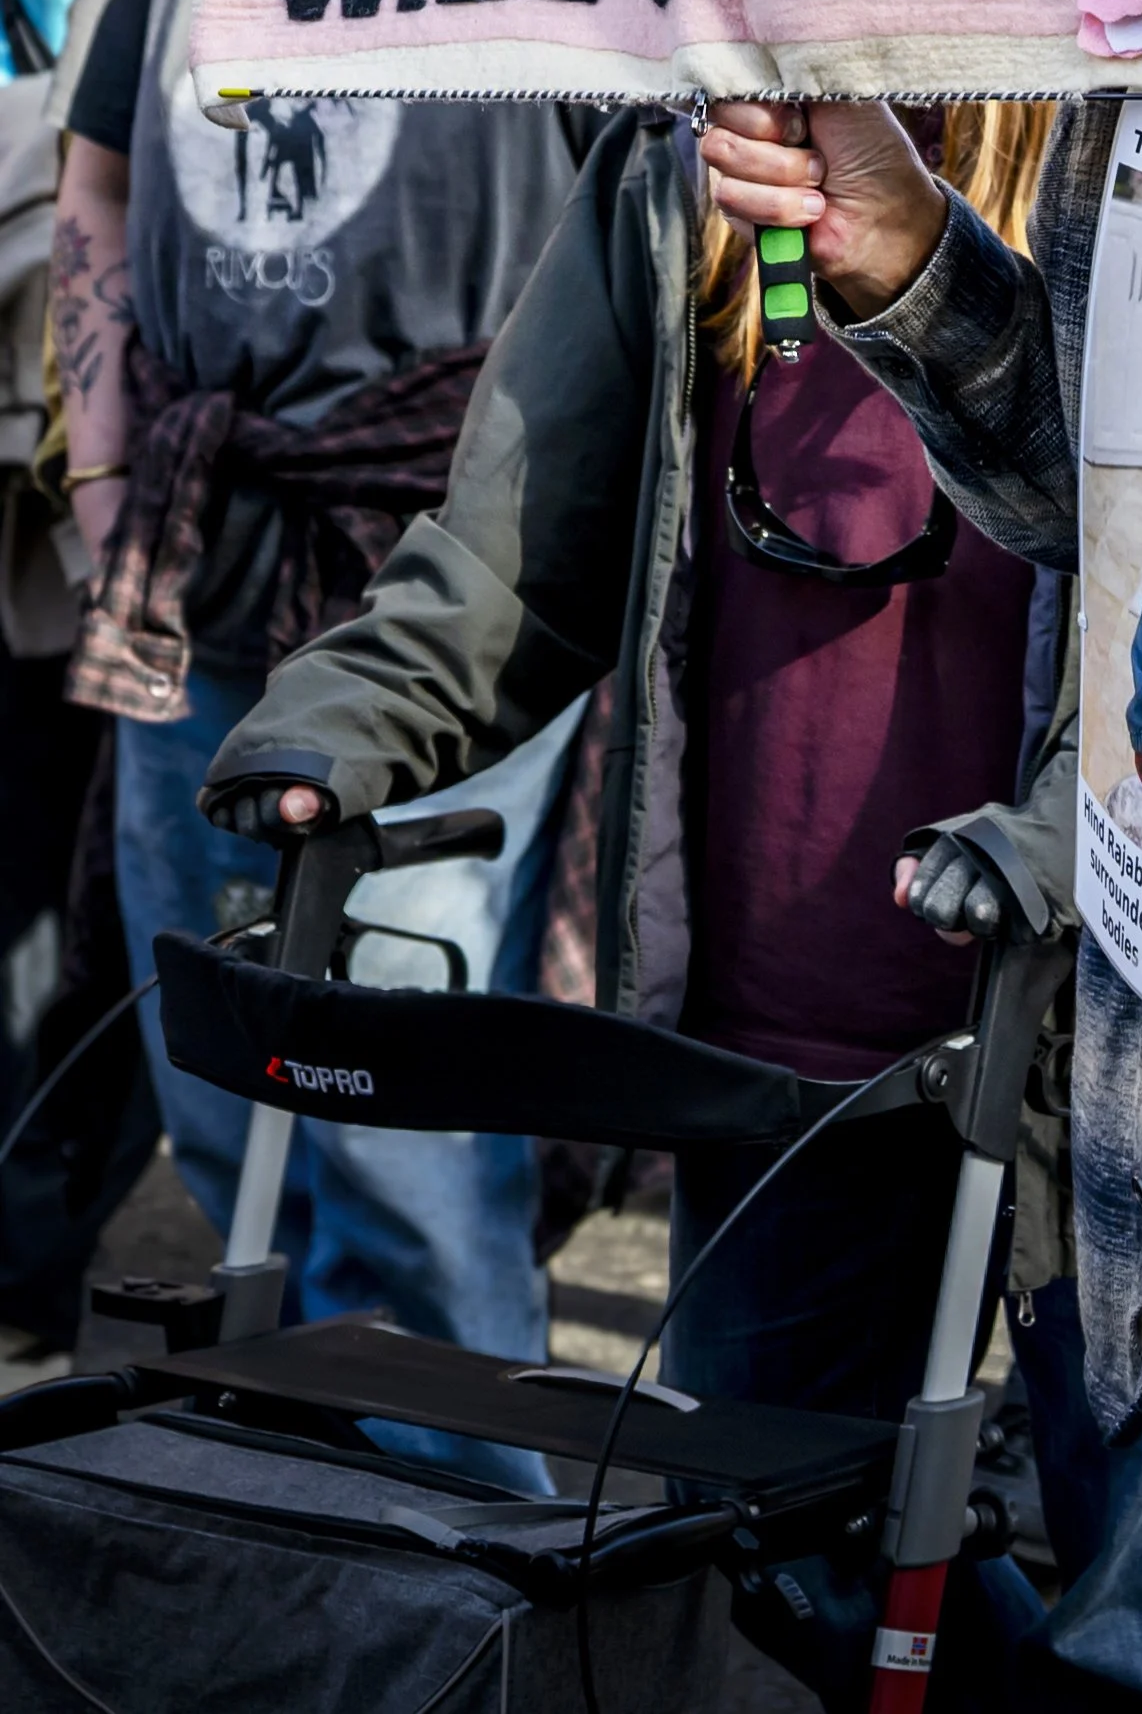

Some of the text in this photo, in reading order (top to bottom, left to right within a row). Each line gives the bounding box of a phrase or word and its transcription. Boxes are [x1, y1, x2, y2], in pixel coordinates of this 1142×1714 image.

[1083, 791, 1105, 846] Hind
[1102, 897, 1139, 968] bodies
[283, 1059, 375, 1096] TOPRO
[886, 1654, 910, 1666] Made
